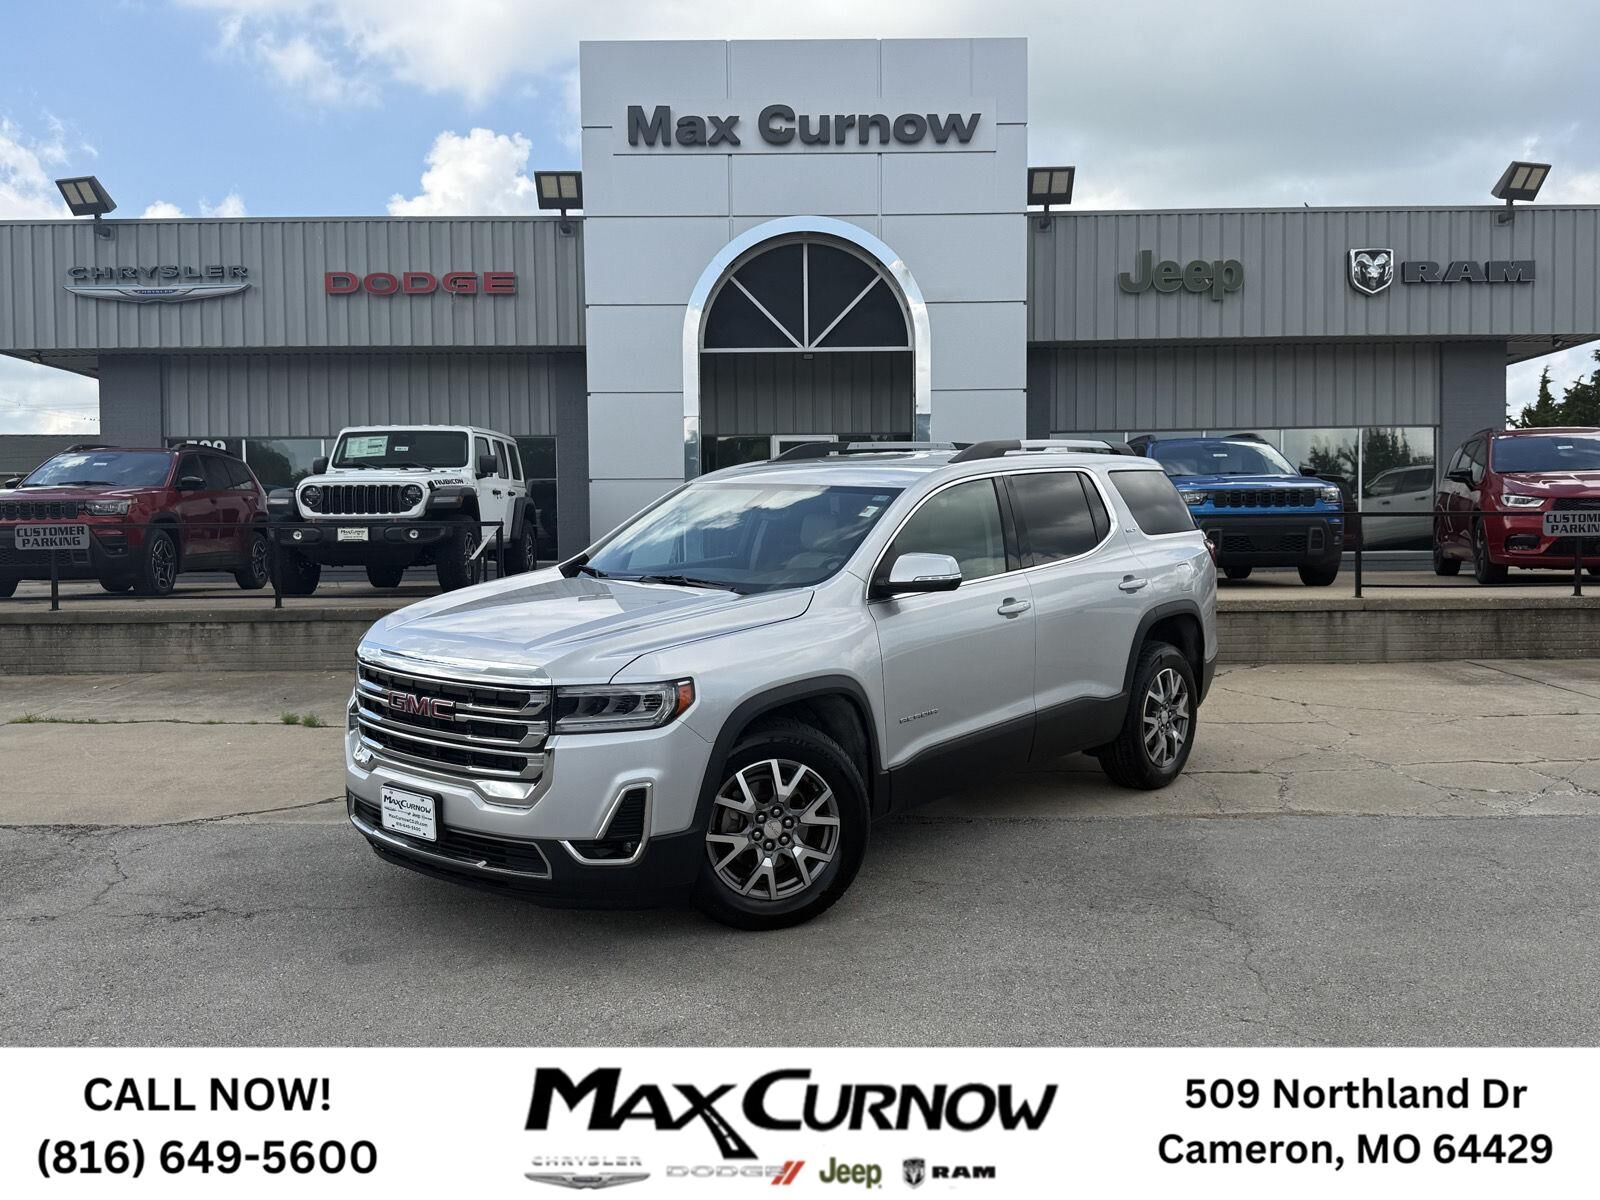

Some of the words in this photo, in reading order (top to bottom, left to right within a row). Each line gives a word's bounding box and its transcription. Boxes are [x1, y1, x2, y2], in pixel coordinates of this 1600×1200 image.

[627, 105, 741, 147] Max
[757, 104, 982, 147] Curnow
[67, 265, 249, 280] CHRYSLER
[1118, 249, 1245, 301] Jeep
[1402, 259, 1537, 284] RAM
[324, 270, 518, 296] DODGE
[433, 478, 465, 486] RUBICON
[1546, 513, 1600, 524] CUSTOM
[16, 526, 85, 538] CUSTOMER
[22, 536, 81, 548] PARKING
[387, 690, 454, 721] GMC
